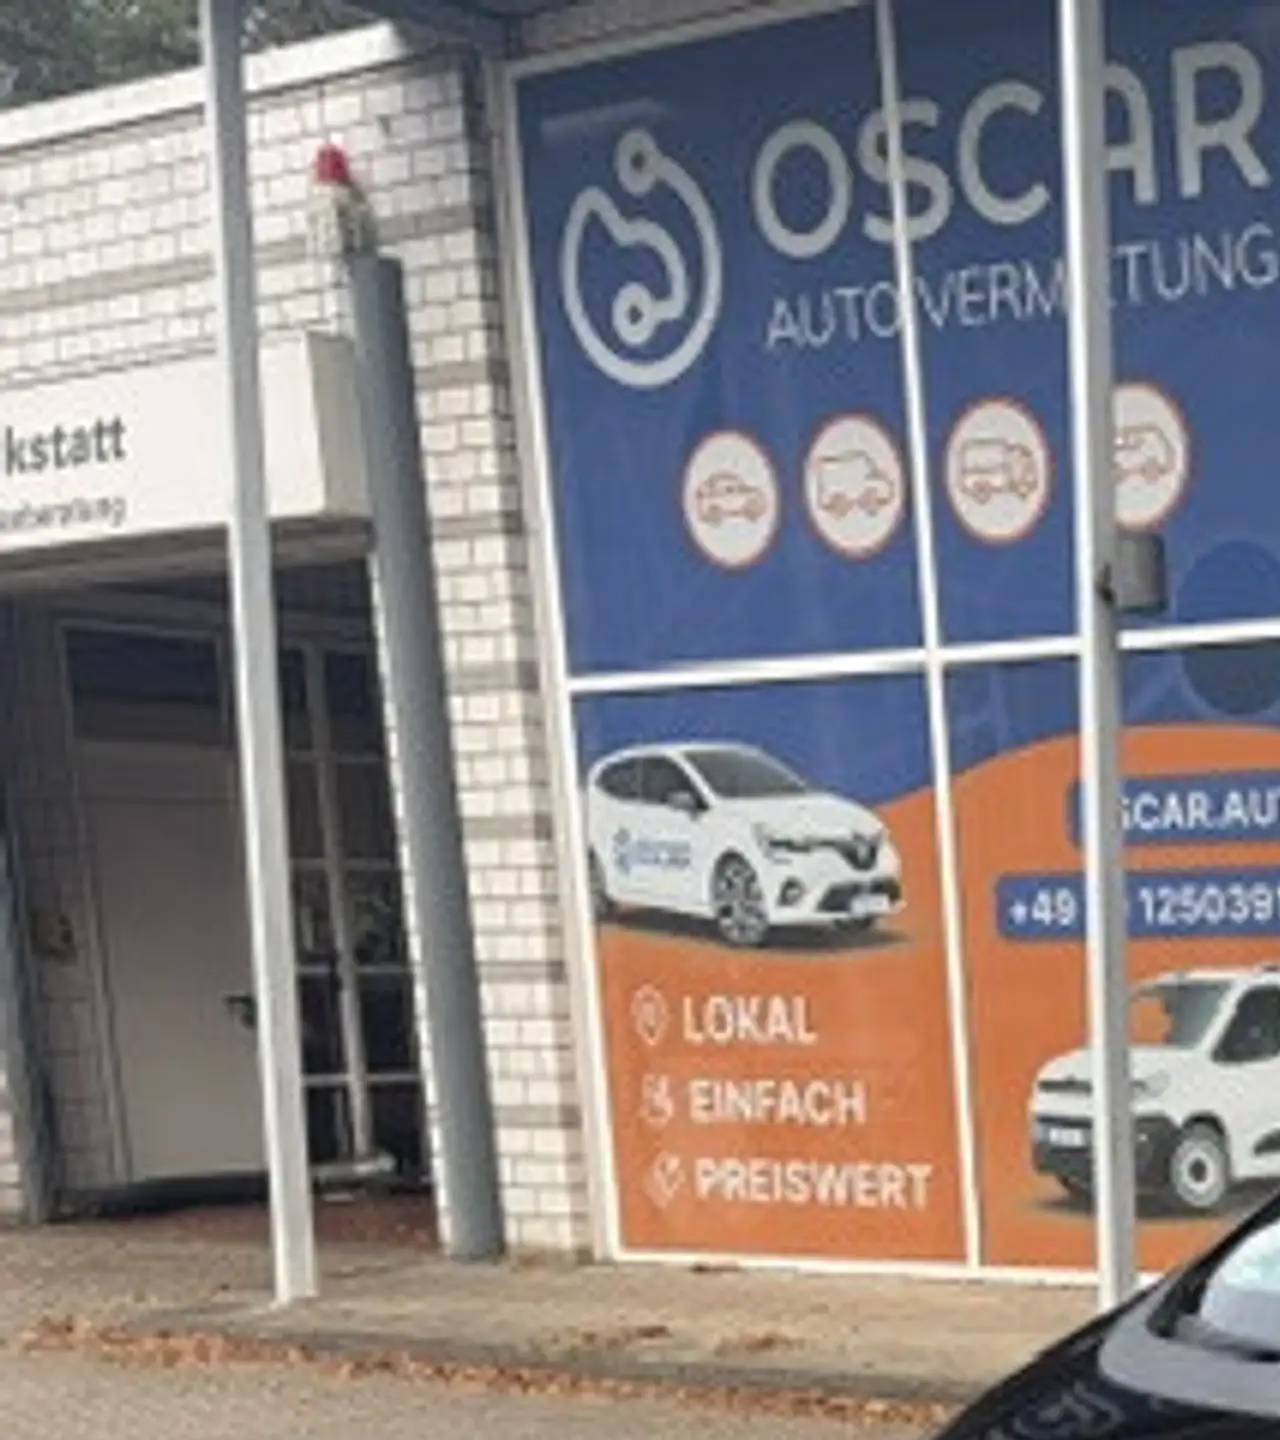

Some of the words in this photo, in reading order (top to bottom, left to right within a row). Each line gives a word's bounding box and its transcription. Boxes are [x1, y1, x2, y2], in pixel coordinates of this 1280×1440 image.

[766, 222, 1280, 351] AUTOVERMTUNG
[1008, 887, 1079, 927] +49
[682, 993, 819, 1046] LOKAL
[688, 1077, 868, 1126] EINFACH
[694, 1156, 934, 1211] PREISWERT
